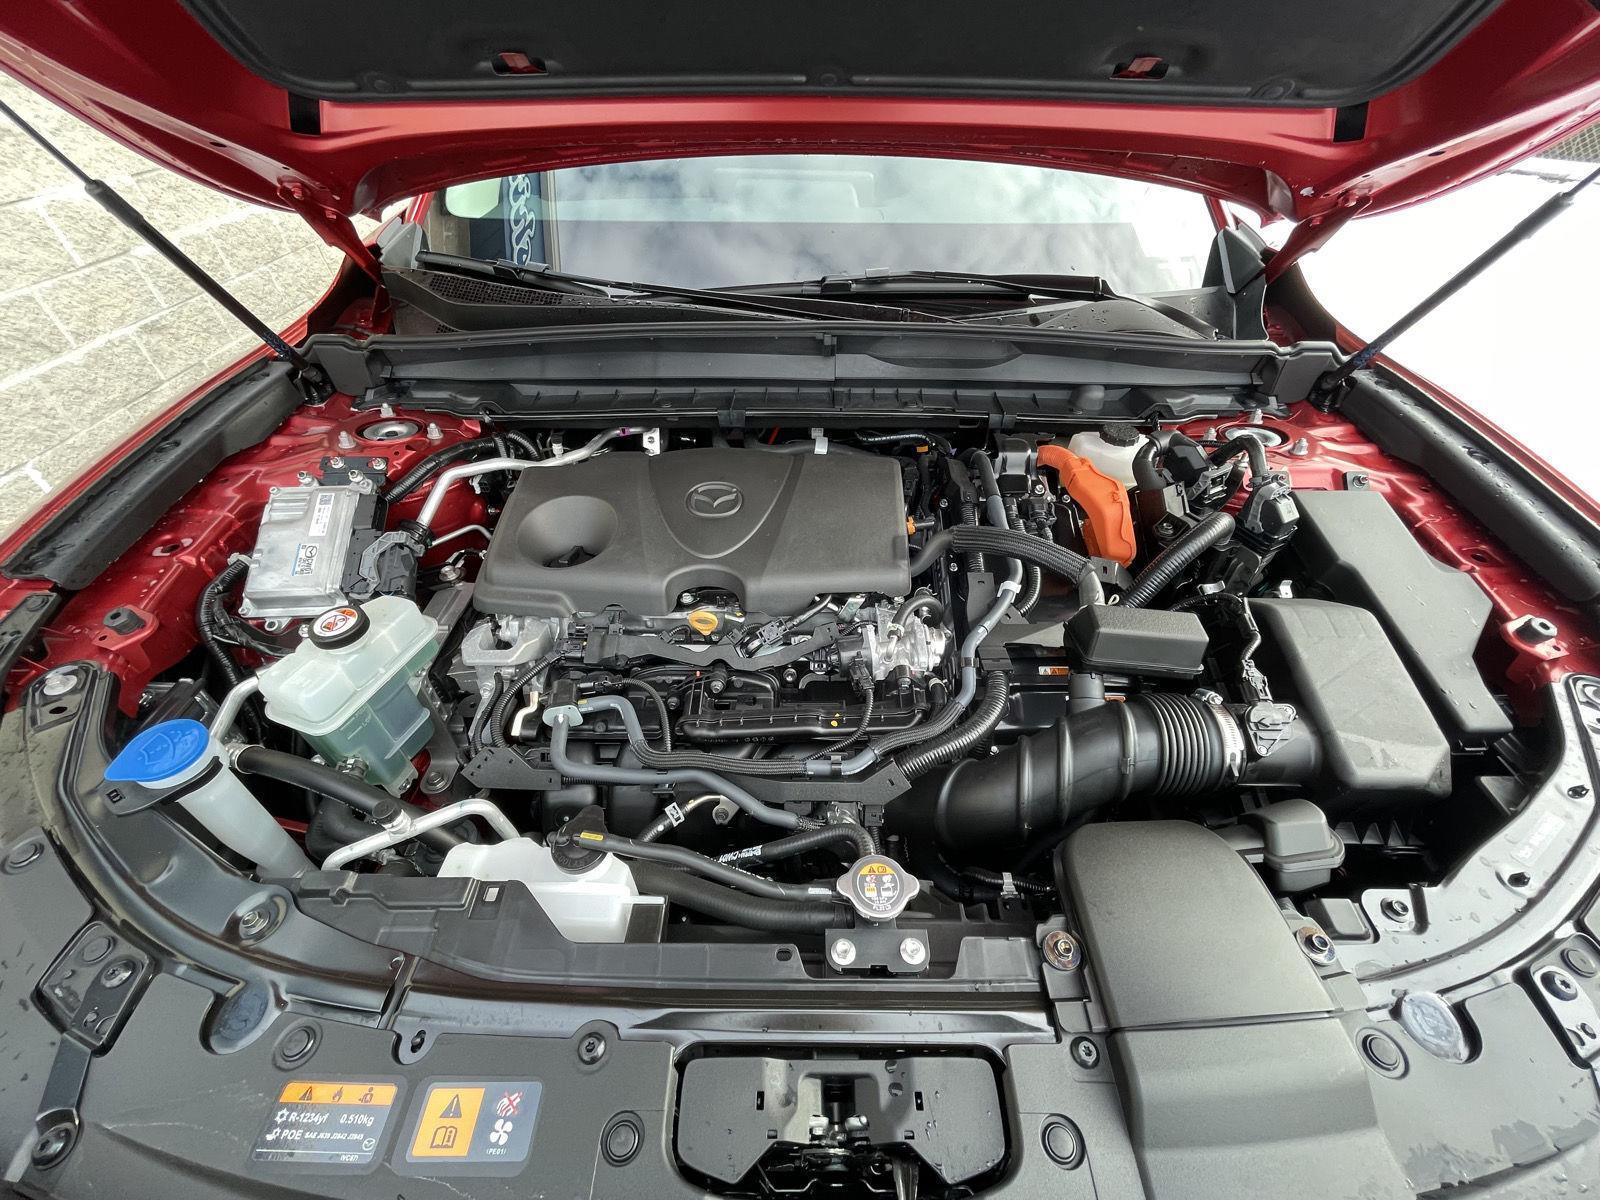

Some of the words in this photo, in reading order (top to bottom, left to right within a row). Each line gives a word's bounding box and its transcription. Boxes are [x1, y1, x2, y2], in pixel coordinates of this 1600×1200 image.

[288, 1112, 329, 1125] R-1234yf
[340, 1113, 374, 1126] 0.510kg
[281, 1130, 303, 1140] POE
